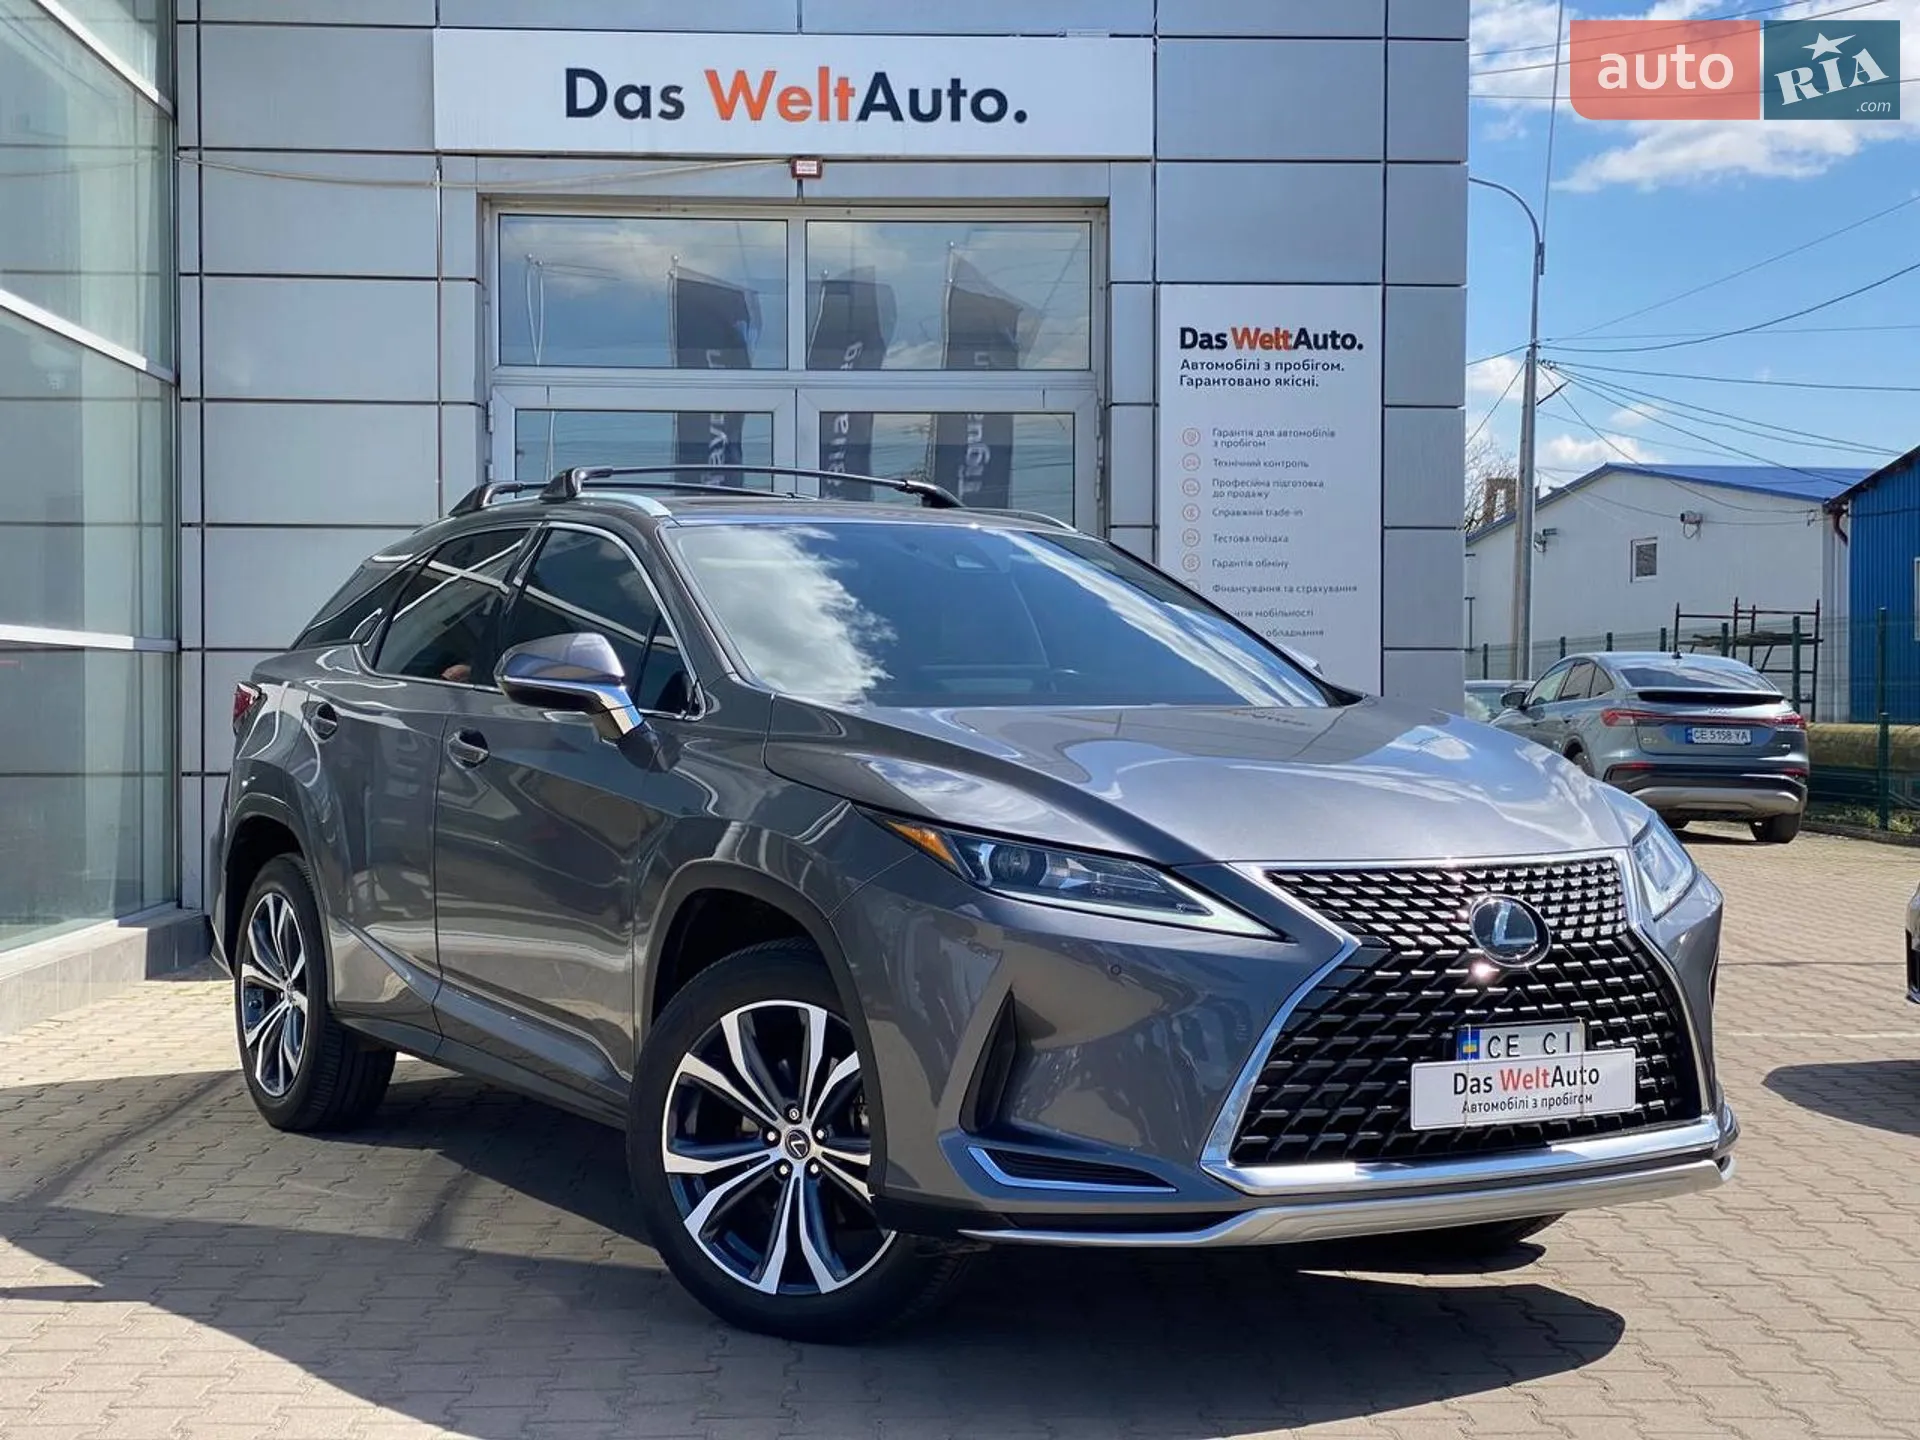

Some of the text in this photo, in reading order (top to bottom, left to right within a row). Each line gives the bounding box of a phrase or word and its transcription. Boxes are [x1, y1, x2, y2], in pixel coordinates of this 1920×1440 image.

[565, 67, 686, 122] Das
[1179, 327, 1228, 350] Das
[1180, 359, 1345, 374] Автомобілі з пробігом.
[1180, 375, 1319, 388] Гарантовано якісні.
[1221, 439, 1266, 448] пробігом
[1487, 1034, 1520, 1058] CE
[1453, 1072, 1492, 1095] Das
[1462, 1092, 1593, 1114] Автомобілі з пробігом
